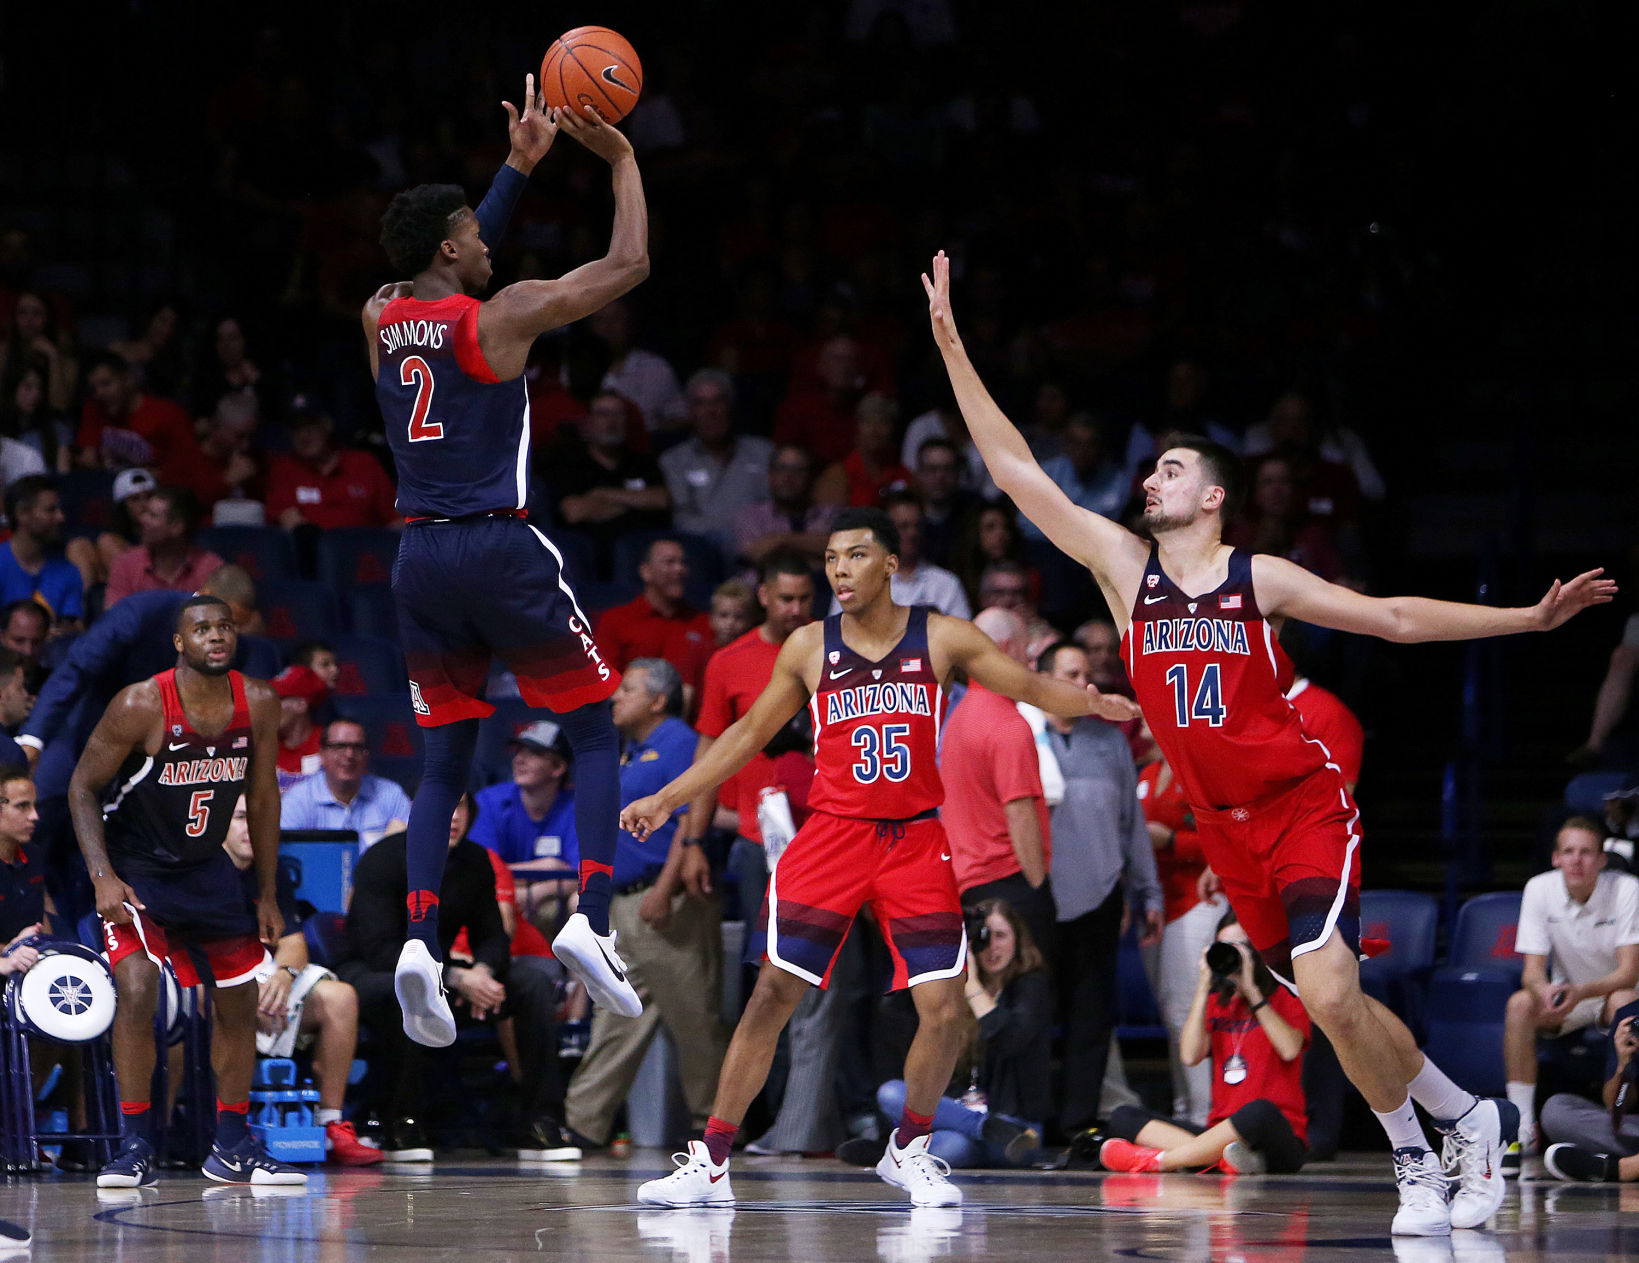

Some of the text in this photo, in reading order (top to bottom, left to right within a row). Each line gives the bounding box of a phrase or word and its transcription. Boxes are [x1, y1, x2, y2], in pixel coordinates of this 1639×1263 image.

[380, 320, 448, 355] SIMMONS
[400, 355, 444, 442] 2
[568, 615, 610, 681] CATS
[1142, 617, 1250, 656] ARIZONA
[827, 682, 931, 725] ARIZONA
[1165, 663, 1227, 727] 14
[851, 723, 912, 784] 35
[185, 789, 214, 837] 5
